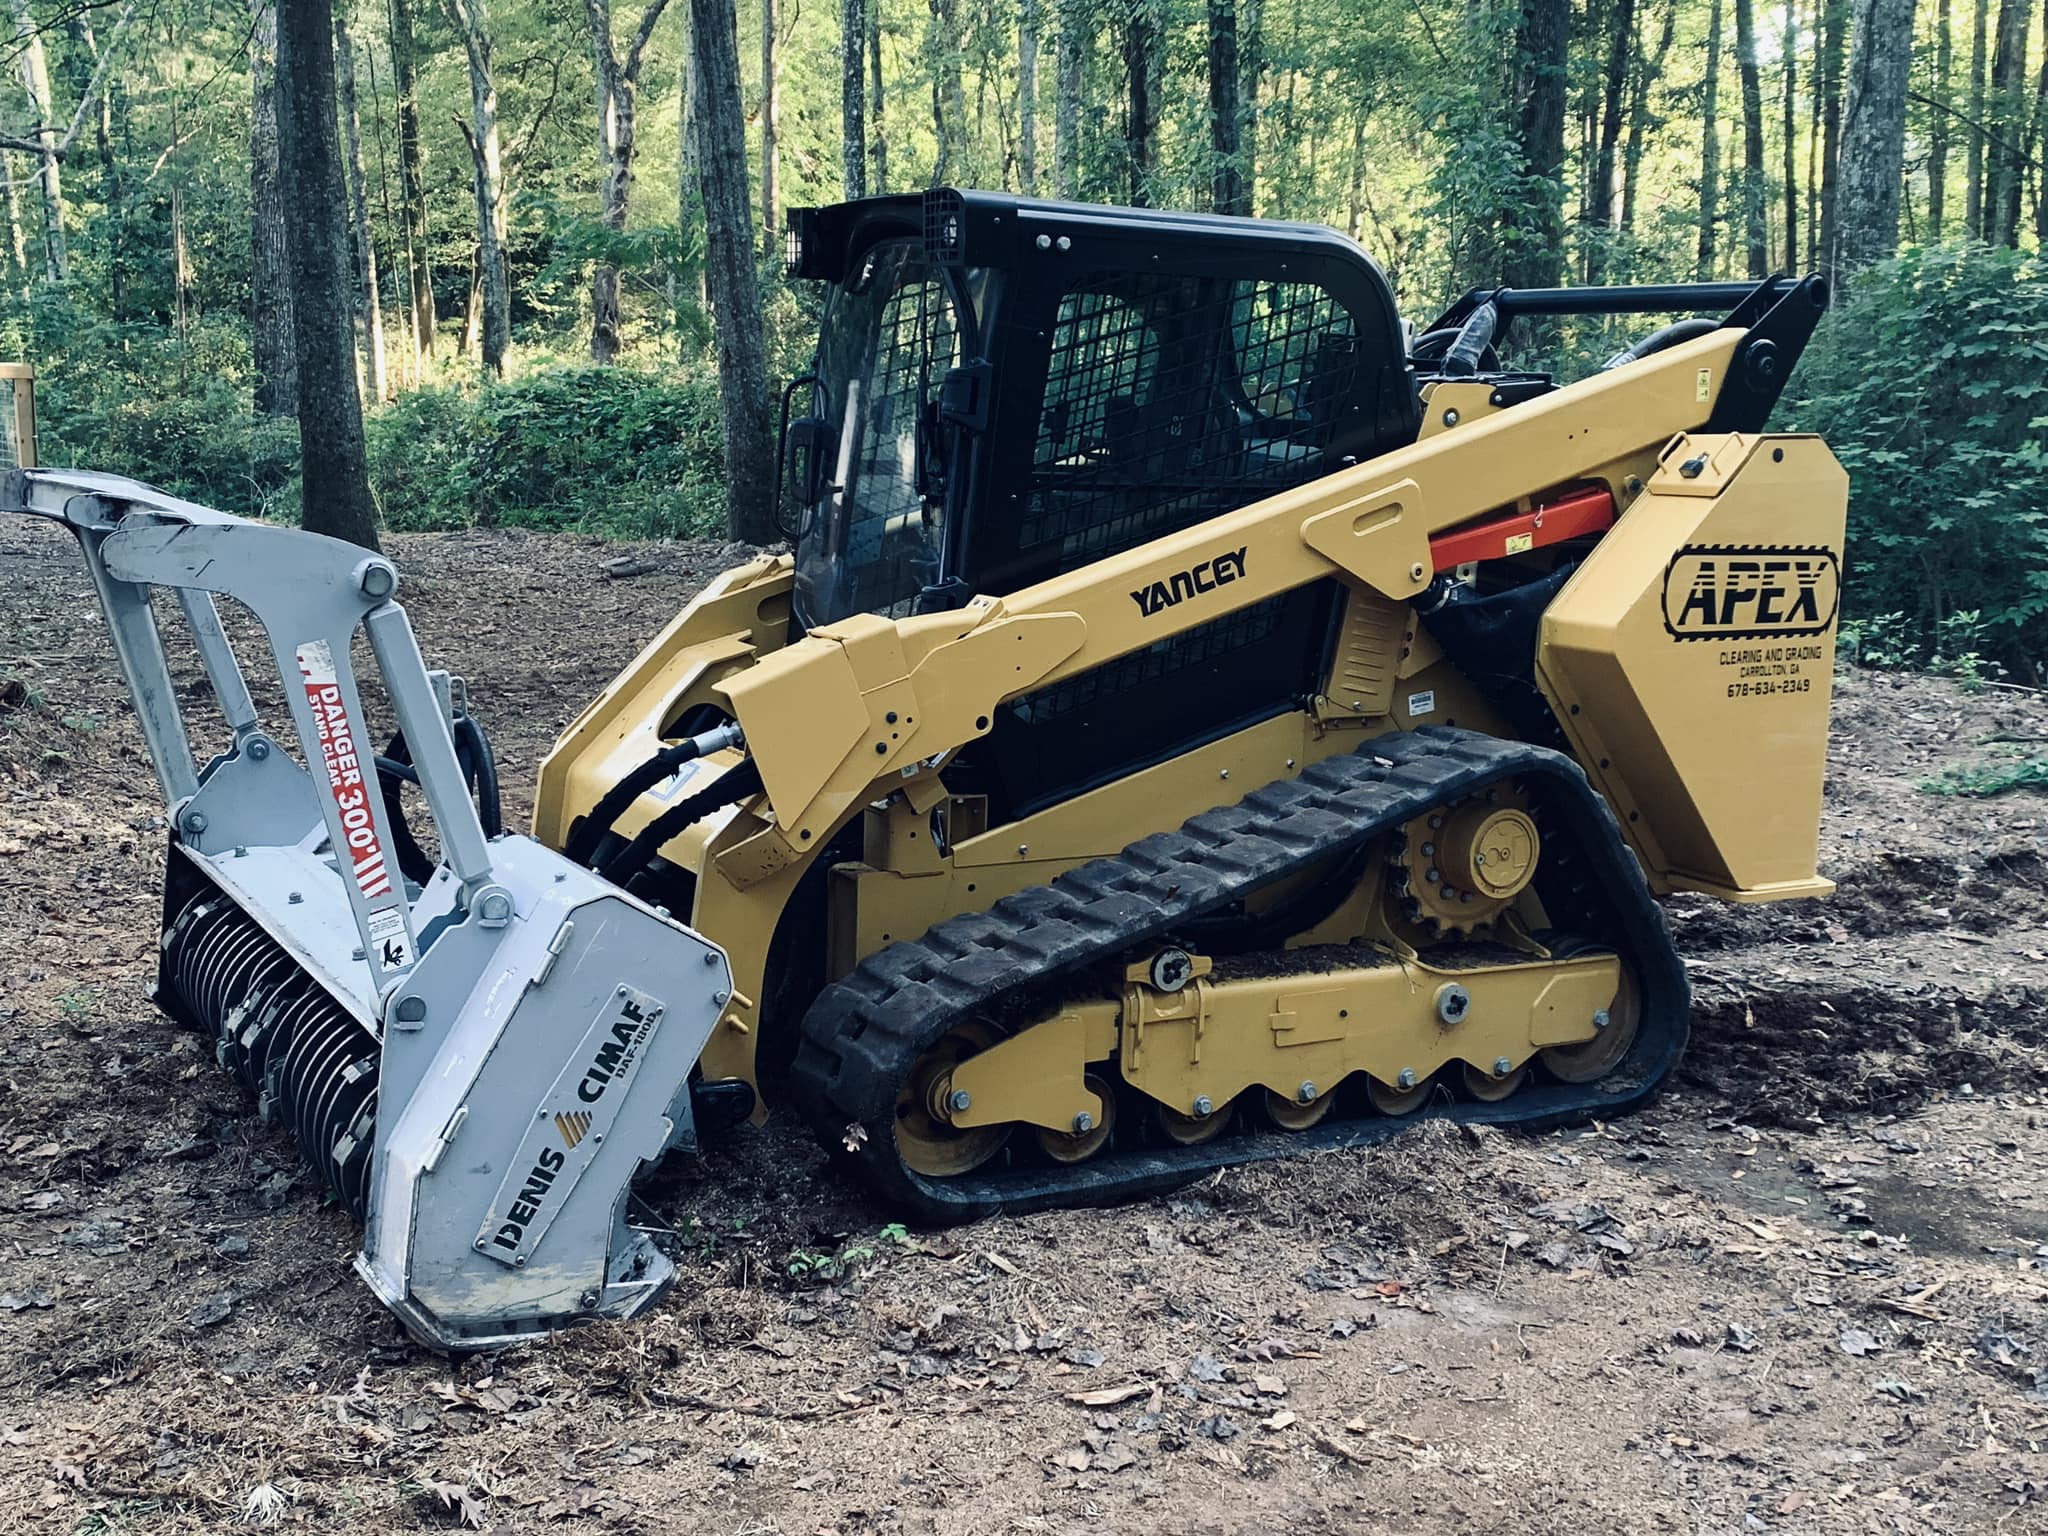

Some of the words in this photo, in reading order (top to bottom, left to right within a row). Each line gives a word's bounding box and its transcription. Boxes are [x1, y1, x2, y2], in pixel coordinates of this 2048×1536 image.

[1129, 546, 1248, 617] YANCEY
[1677, 562, 1828, 625] APEX
[1719, 649, 1762, 666] CLEARING
[1765, 647, 1783, 661] AND
[1785, 646, 1822, 661] GRADING
[1727, 679, 1810, 698] 678-634-2349
[1790, 663, 1800, 674] GA
[309, 694, 329, 740] STAND
[322, 742, 342, 788] CLEAR
[320, 686, 361, 788] DANGER
[614, 1012, 657, 1079] DAF-180D
[493, 1147, 565, 1251] DENIS
[577, 1000, 645, 1104] CIMAF
